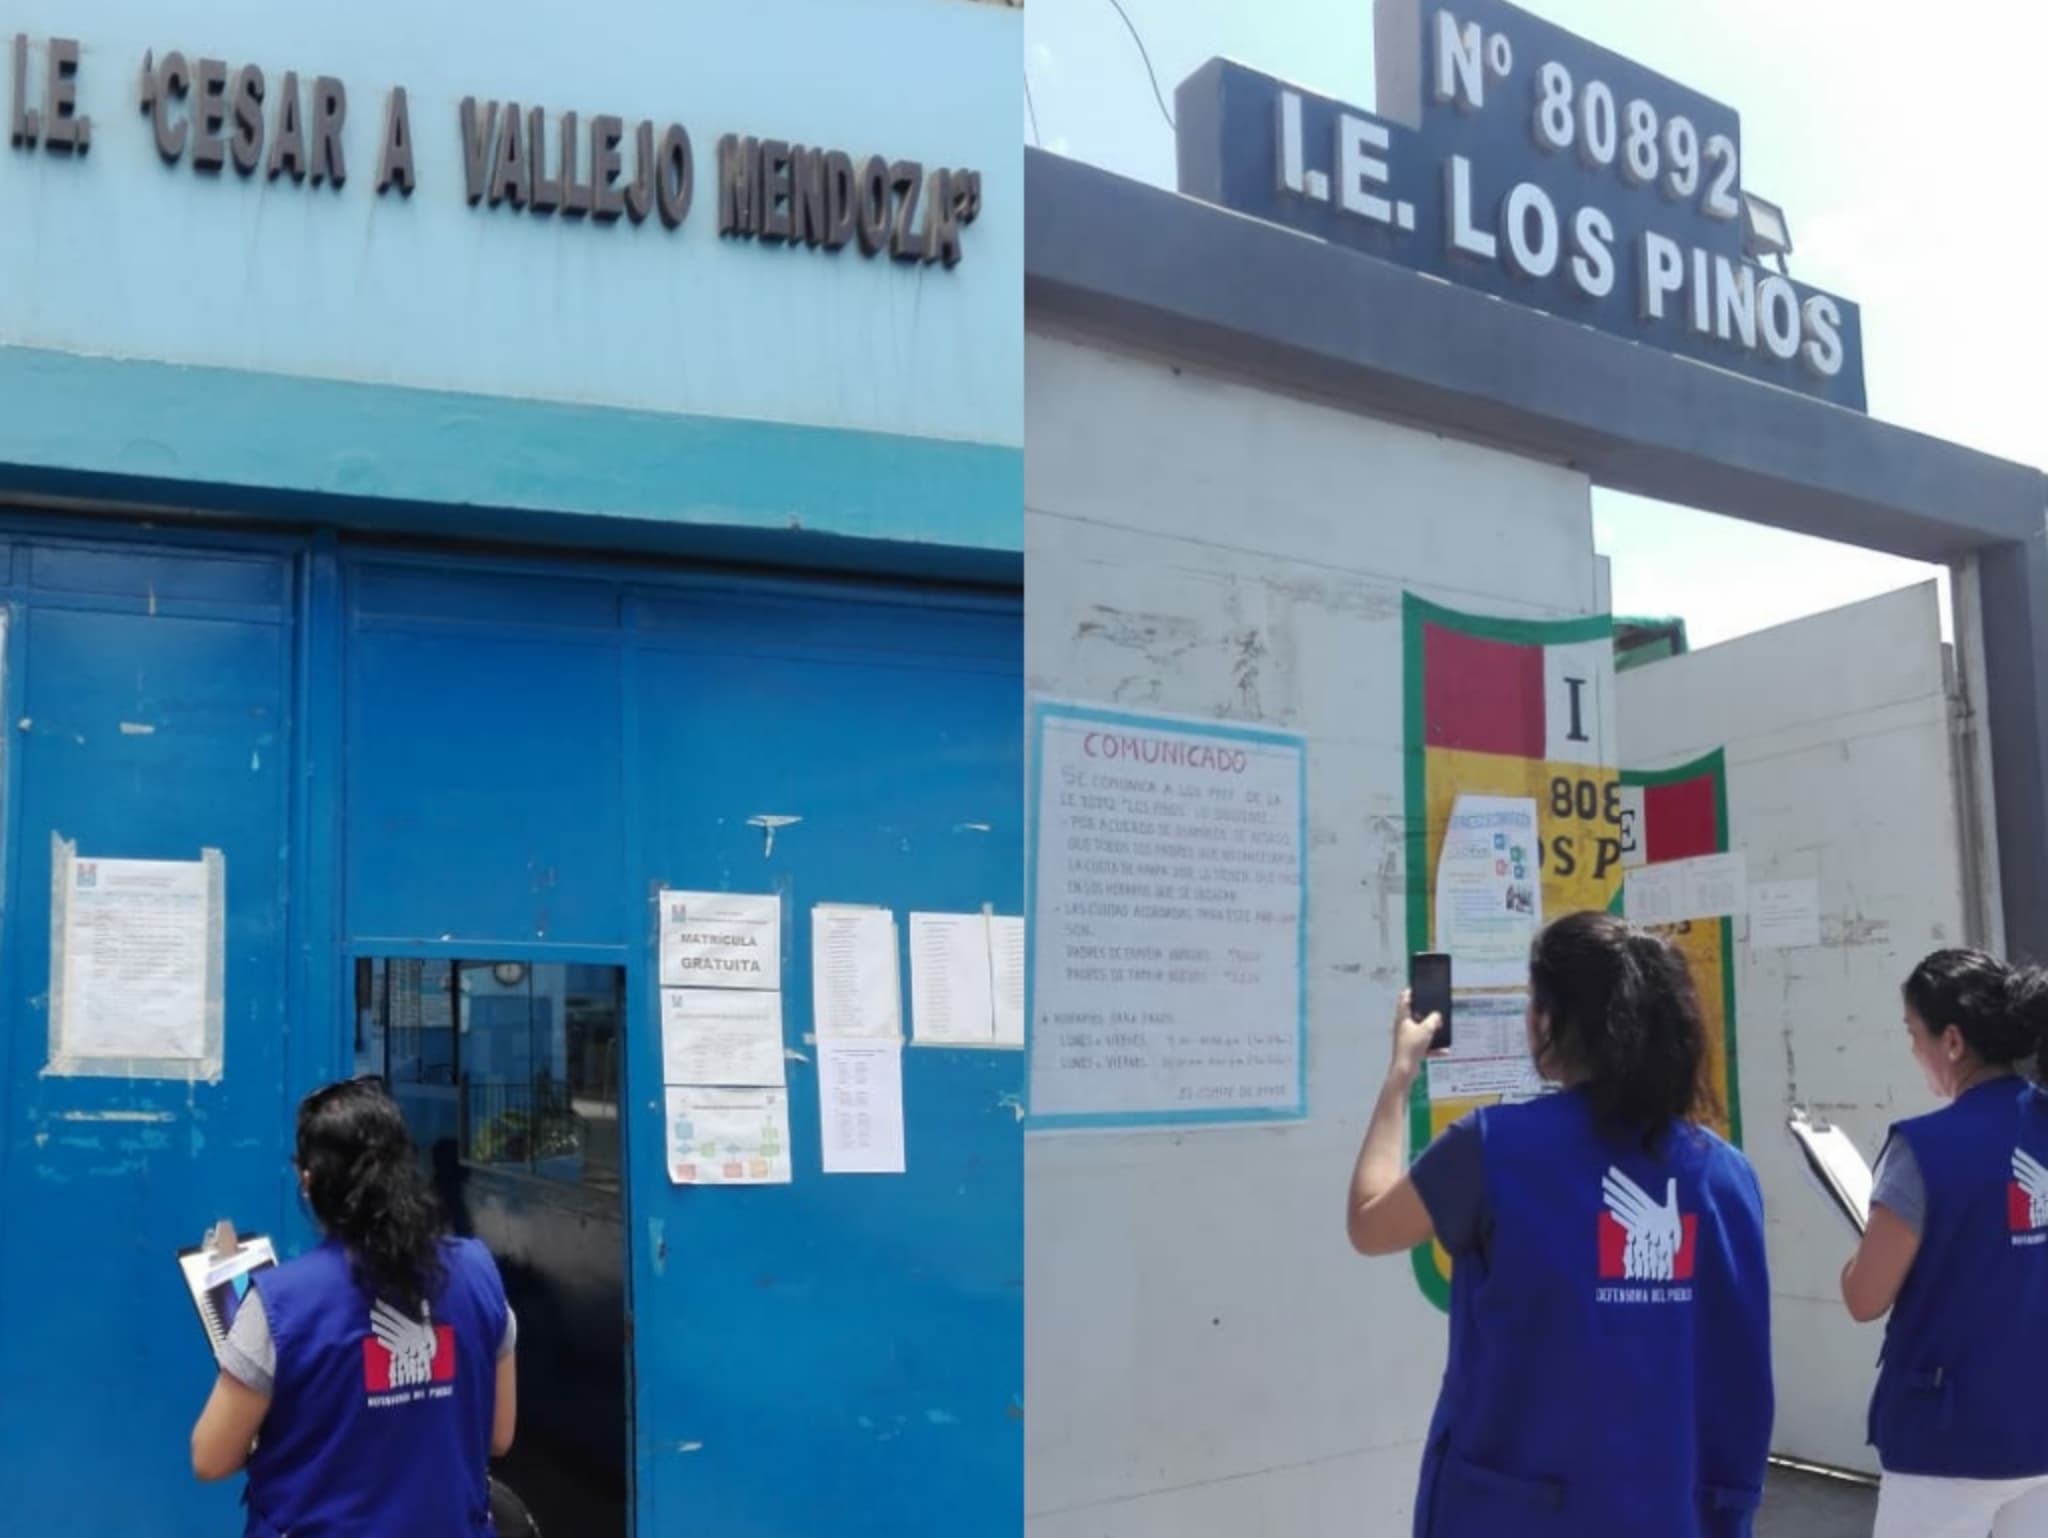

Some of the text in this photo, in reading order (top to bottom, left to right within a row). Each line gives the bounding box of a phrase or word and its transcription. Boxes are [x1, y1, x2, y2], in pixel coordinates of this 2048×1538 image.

[11, 33, 90, 156] I.E.
[376, 85, 416, 199] A
[460, 95, 694, 231] VALLEJO
[1536, 61, 1740, 220] 80892
[1277, 90, 1844, 377] I.E. LOS PINOS
[1564, 676, 1590, 742] I
[1083, 732, 1247, 774] COMUNICADO
[680, 933, 757, 947] MATRICULA
[680, 957, 761, 972] GRATUITA
